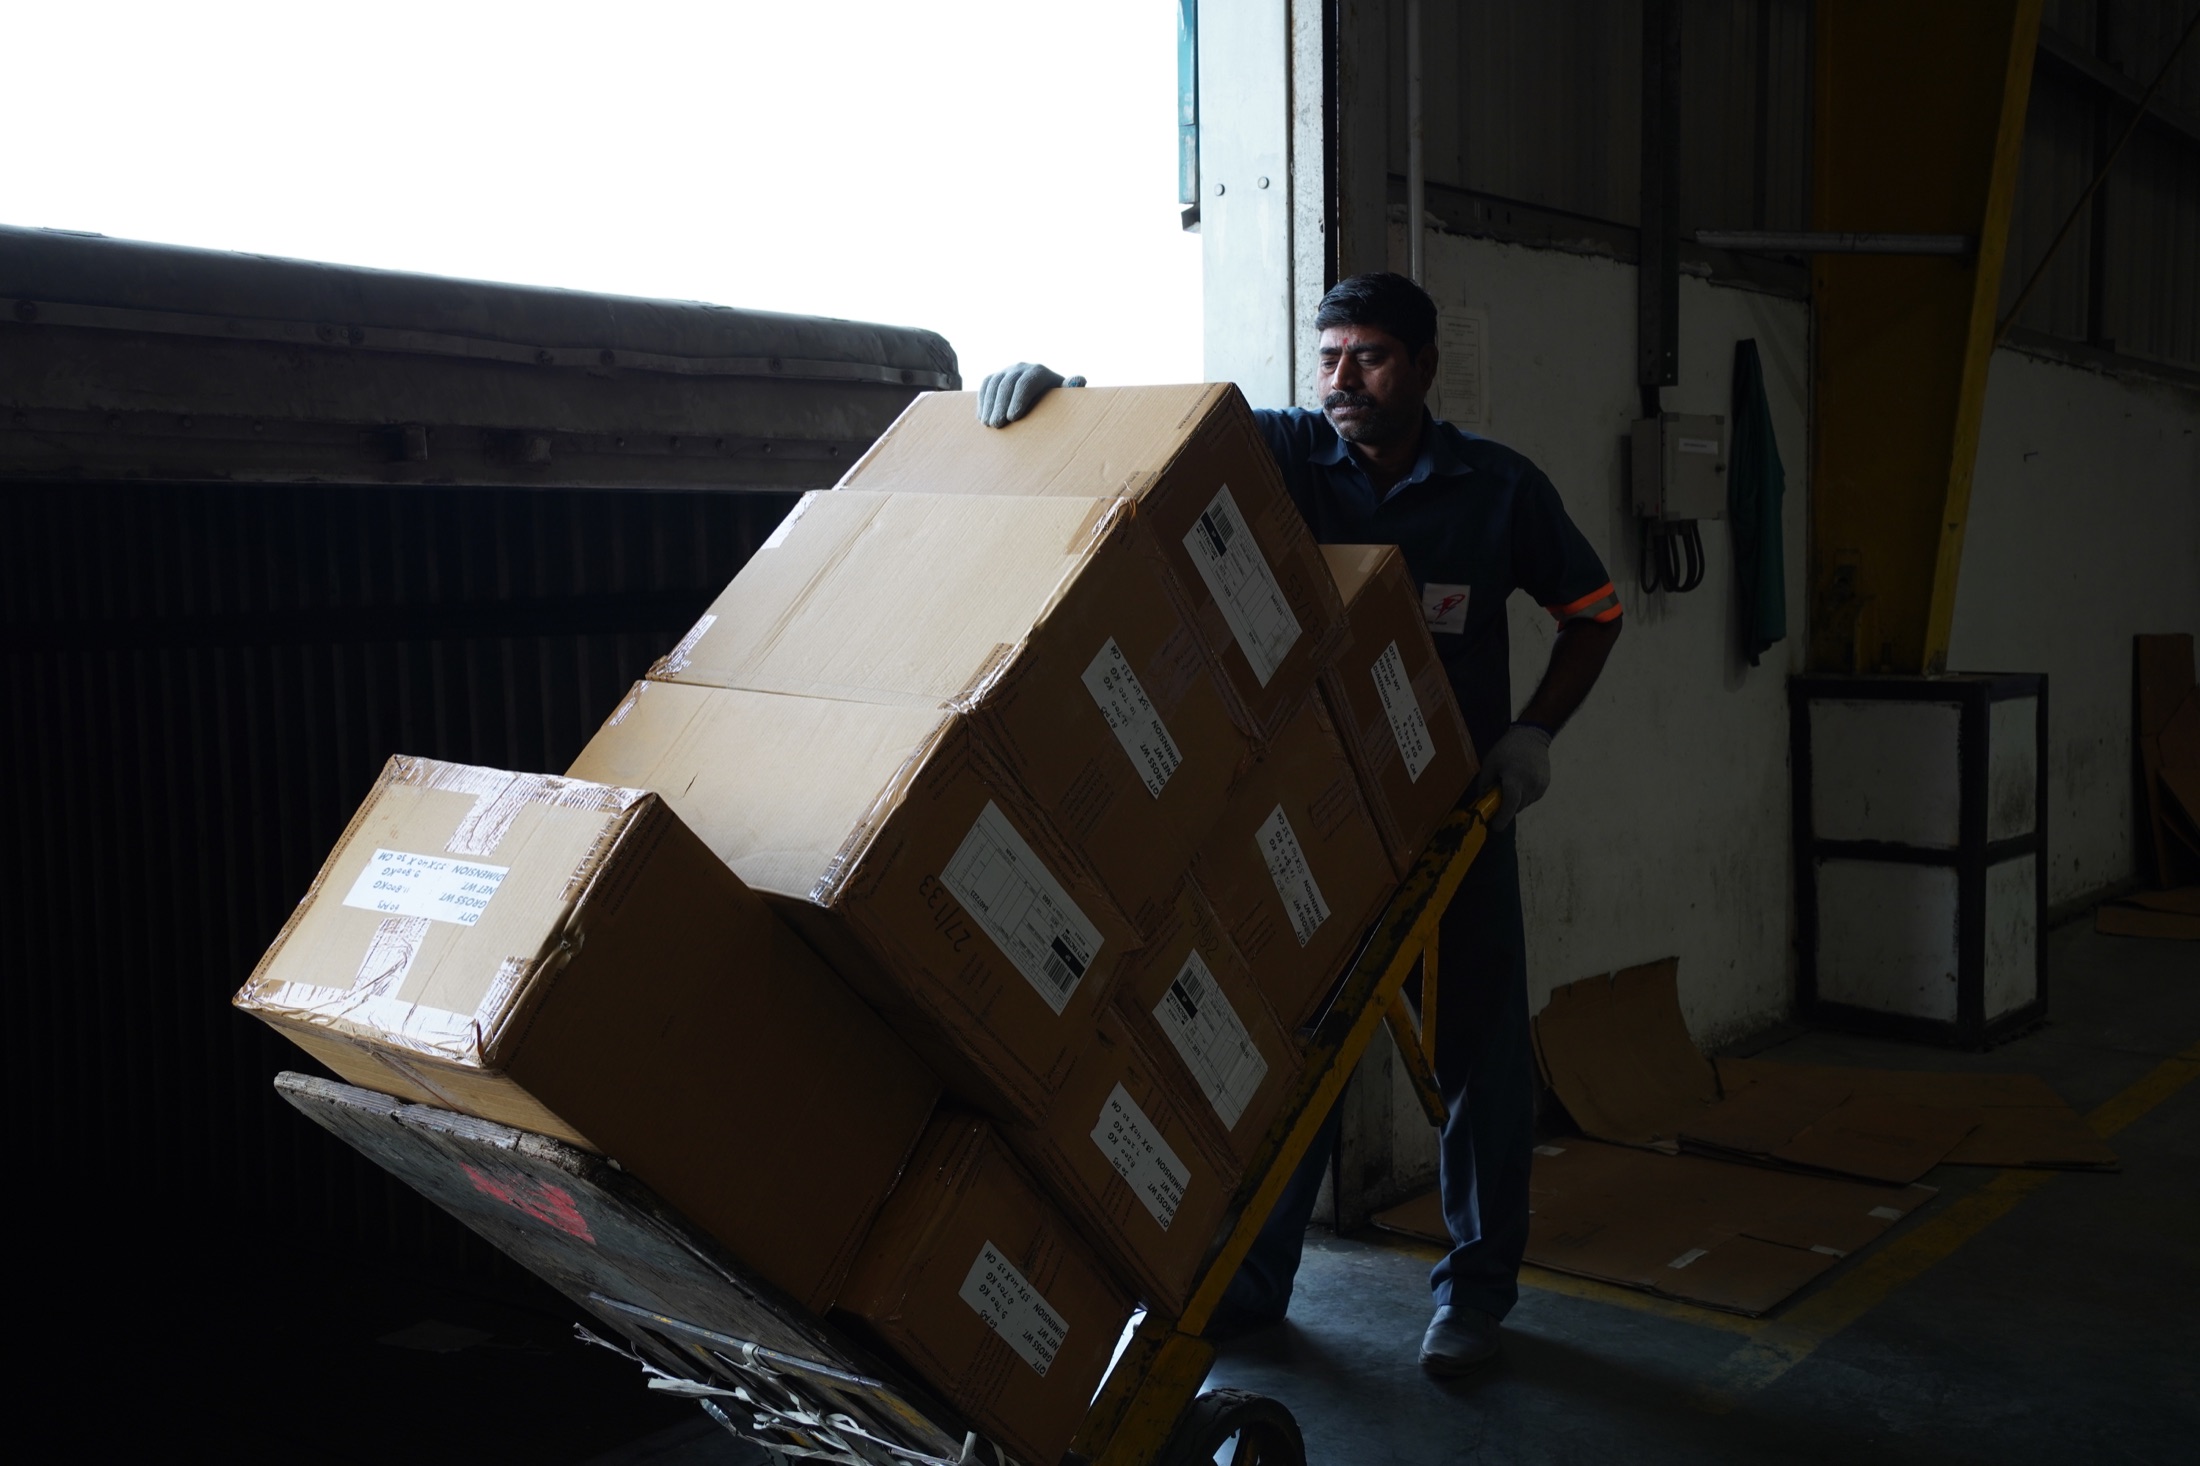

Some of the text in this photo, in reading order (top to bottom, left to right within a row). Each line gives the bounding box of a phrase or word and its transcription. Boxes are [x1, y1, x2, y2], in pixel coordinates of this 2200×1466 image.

[1197, 523, 1218, 559] FIFTY FACTORY
[1285, 573, 1325, 645] 53/133
[1109, 643, 1121, 661] CM
[1109, 664, 1121, 682] KG
[1102, 674, 1114, 692] KG
[1377, 657, 1386, 675] NET
[1410, 744, 1417, 759] KG
[1382, 650, 1395, 679] GROSS
[1415, 738, 1422, 752] KG
[1372, 664, 1391, 710] DIMENSION
[1409, 761, 1416, 776] CM
[1149, 717, 1180, 769] DIMENSION
[1146, 755, 1166, 787] GROSS
[1160, 757, 1173, 778] NET
[1276, 810, 1285, 826] CM
[1268, 836, 1277, 852] KG
[1274, 829, 1283, 844] KG
[377, 851, 394, 861] CM
[1004, 847, 1016, 862] SPAIN
[449, 864, 506, 881] DIMENSION
[475, 884, 497, 895] NET
[453, 895, 488, 908] GROSS
[969, 888, 988, 912] 8407223
[1302, 878, 1324, 923] DIMENSION
[919, 874, 971, 953] 27/133
[1308, 914, 1317, 931] NET
[1298, 910, 1312, 938] GROSS
[1061, 931, 1087, 964] FIFTY FACTORY
[1168, 991, 1188, 1023] FIFTY FACTORY
[1111, 1098, 1121, 1114] CM
[1112, 1118, 1123, 1134] KG
[1107, 1129, 1118, 1146] KG
[1155, 1155, 1184, 1196] DIMENSION
[1156, 1191, 1174, 1218] GROSS
[1168, 1189, 1180, 1207] NET
[984, 1249, 996, 1265] CM
[985, 1270, 997, 1286] KG
[978, 1281, 990, 1297] KG
[1032, 1301, 1066, 1339] DIMENSION
[1031, 1338, 1053, 1364] GROSS
[1046, 1335, 1059, 1351] NET
